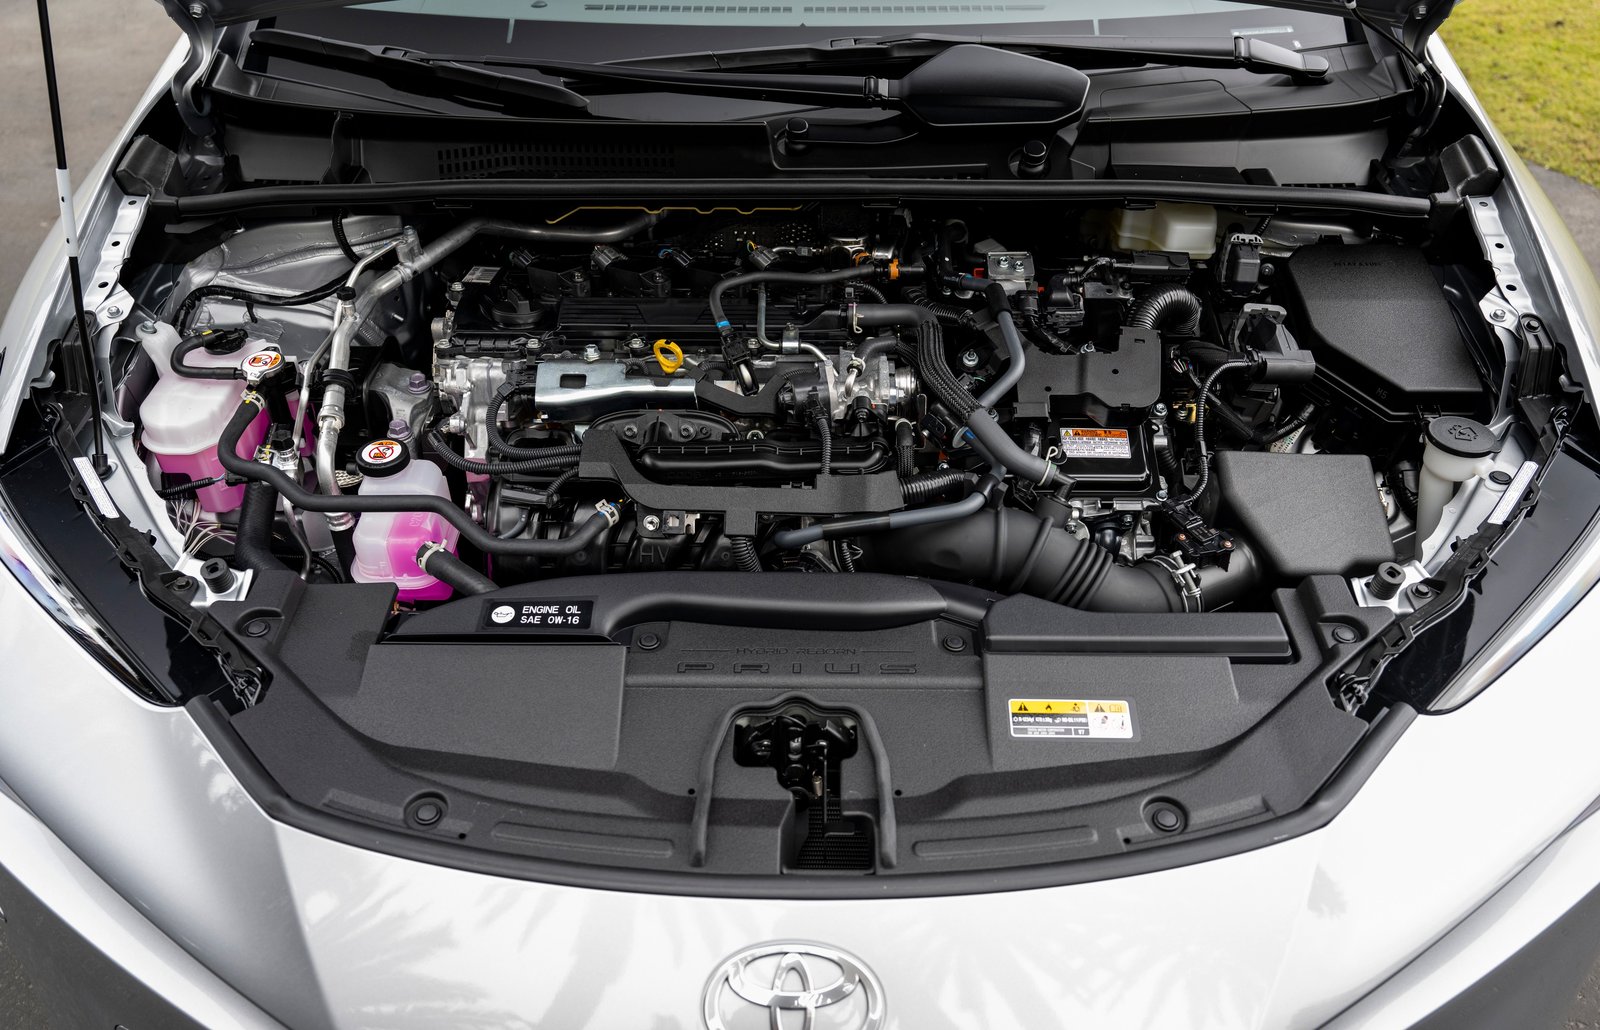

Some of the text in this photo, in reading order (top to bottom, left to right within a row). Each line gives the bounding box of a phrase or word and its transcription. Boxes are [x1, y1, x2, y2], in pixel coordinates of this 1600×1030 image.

[640, 545, 670, 563] HV
[520, 615, 579, 624] SAE 0W-16
[677, 661, 918, 675] PRIUS
